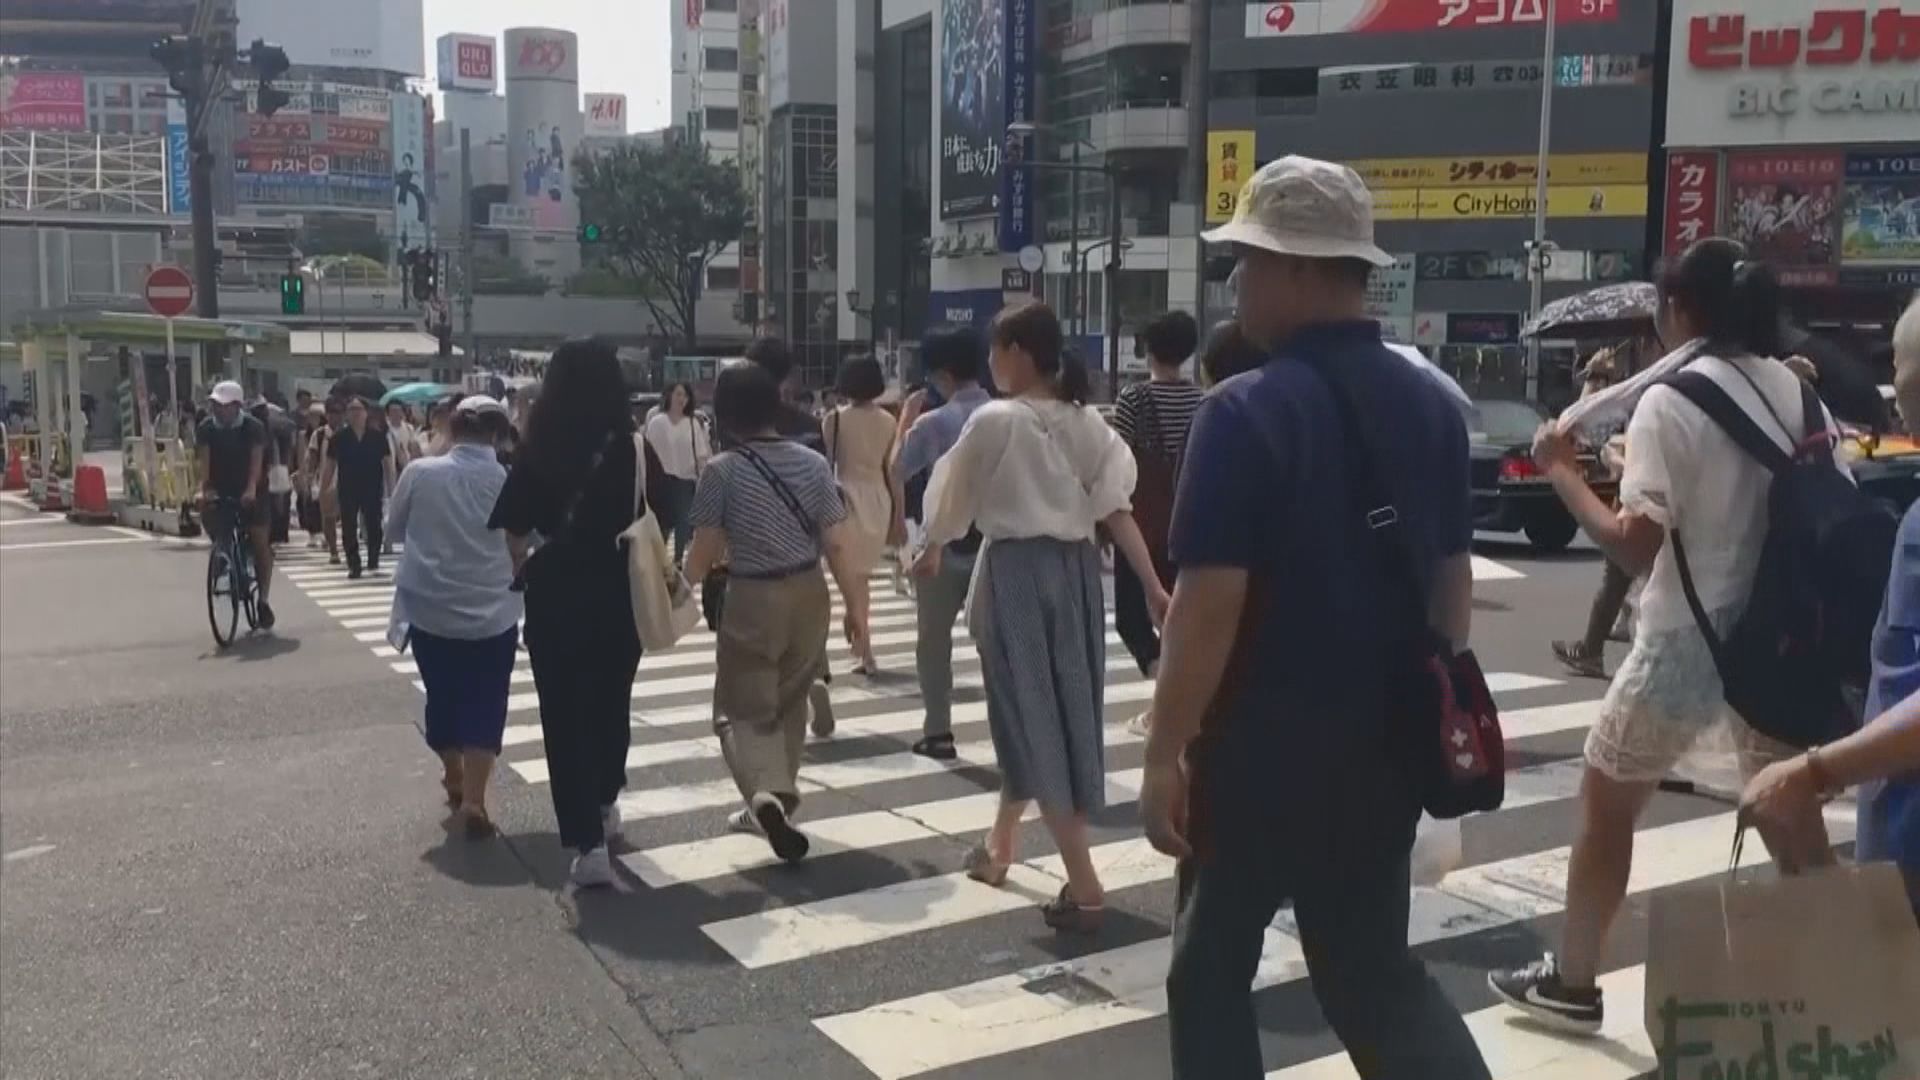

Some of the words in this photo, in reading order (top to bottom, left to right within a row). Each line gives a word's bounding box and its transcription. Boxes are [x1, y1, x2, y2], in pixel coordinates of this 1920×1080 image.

[1438, 0, 1544, 27] アコム
[1730, 82, 1799, 116] BIC
[1453, 193, 1547, 215] CityHom
[1424, 256, 1460, 278] 2F
